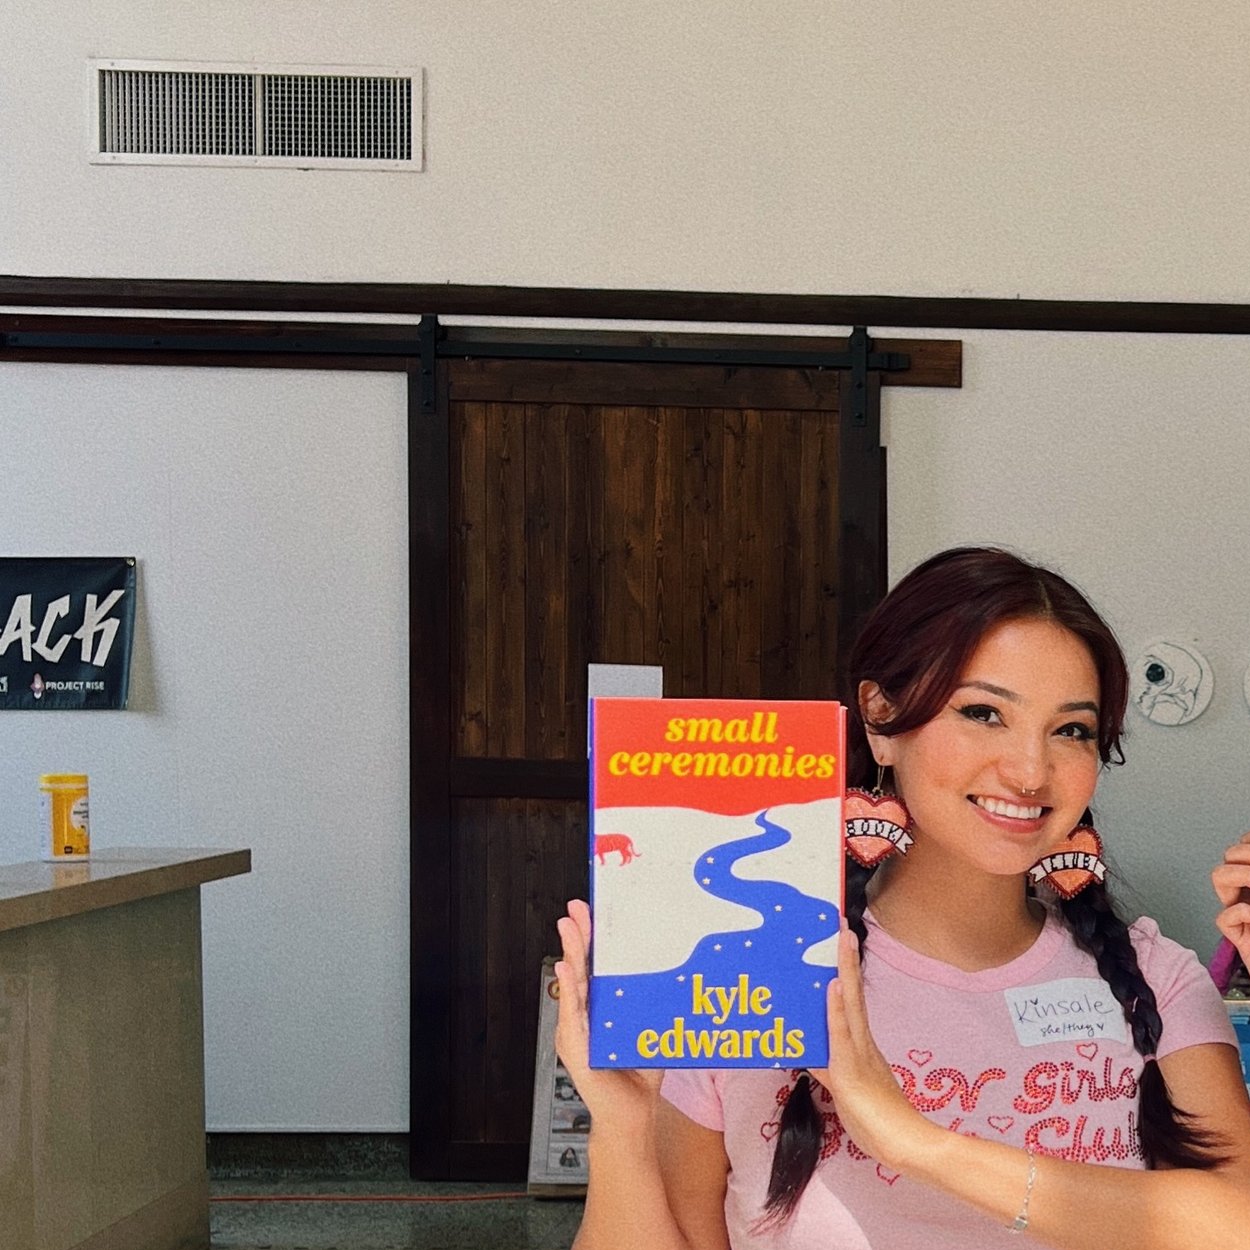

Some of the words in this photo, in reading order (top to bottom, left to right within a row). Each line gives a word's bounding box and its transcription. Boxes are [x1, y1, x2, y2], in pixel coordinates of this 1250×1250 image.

[0, 589, 125, 667] ACK
[45, 681, 84, 690] PROJECT
[85, 681, 105, 690] RISE
[664, 711, 779, 743] small
[608, 745, 837, 779] ceremonies
[692, 973, 773, 1025] kyle
[1014, 994, 1114, 1024] Kinsale
[636, 1017, 806, 1058] edwards
